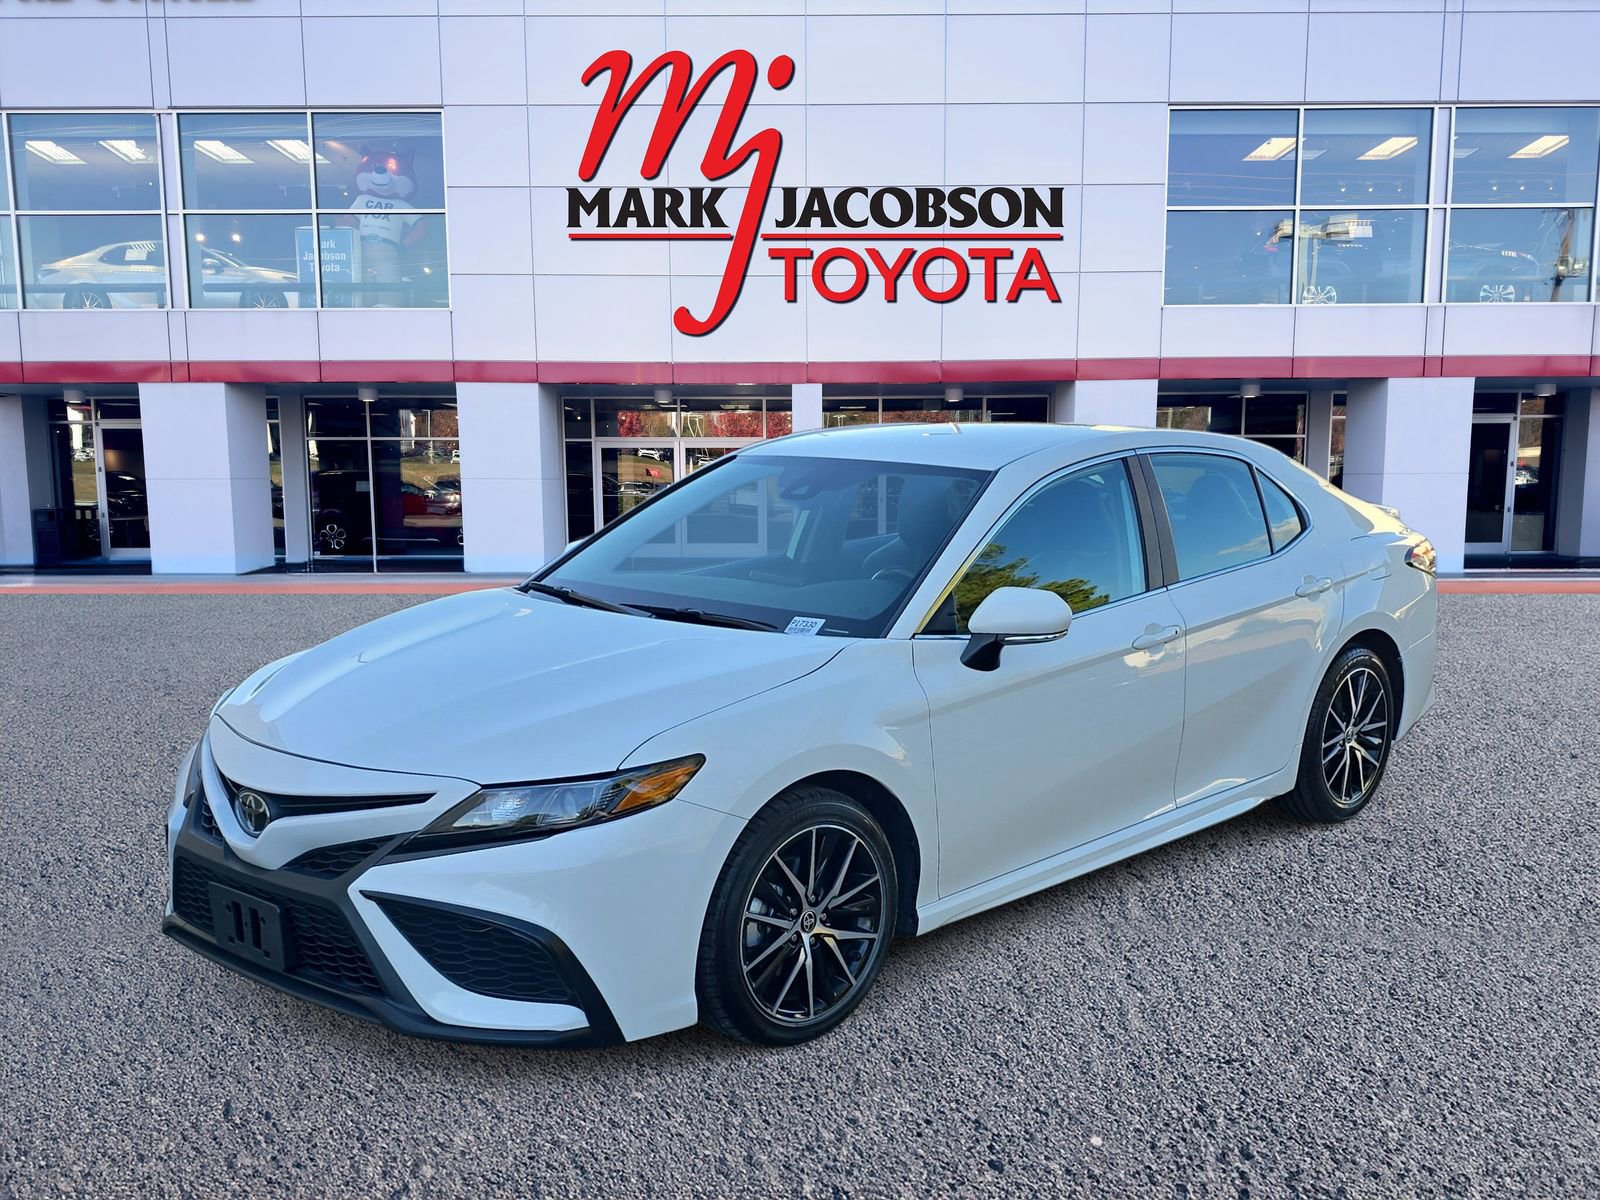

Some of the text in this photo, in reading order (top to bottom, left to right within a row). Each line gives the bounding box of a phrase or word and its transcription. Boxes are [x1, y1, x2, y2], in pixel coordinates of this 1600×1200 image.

[366, 199, 394, 209] CAR
[566, 187, 1065, 228] MARK JACOBSON
[313, 239, 336, 249] ark
[303, 251, 347, 261] Jabson
[309, 262, 340, 273] Tyota
[768, 247, 1062, 304] TOYOTA
